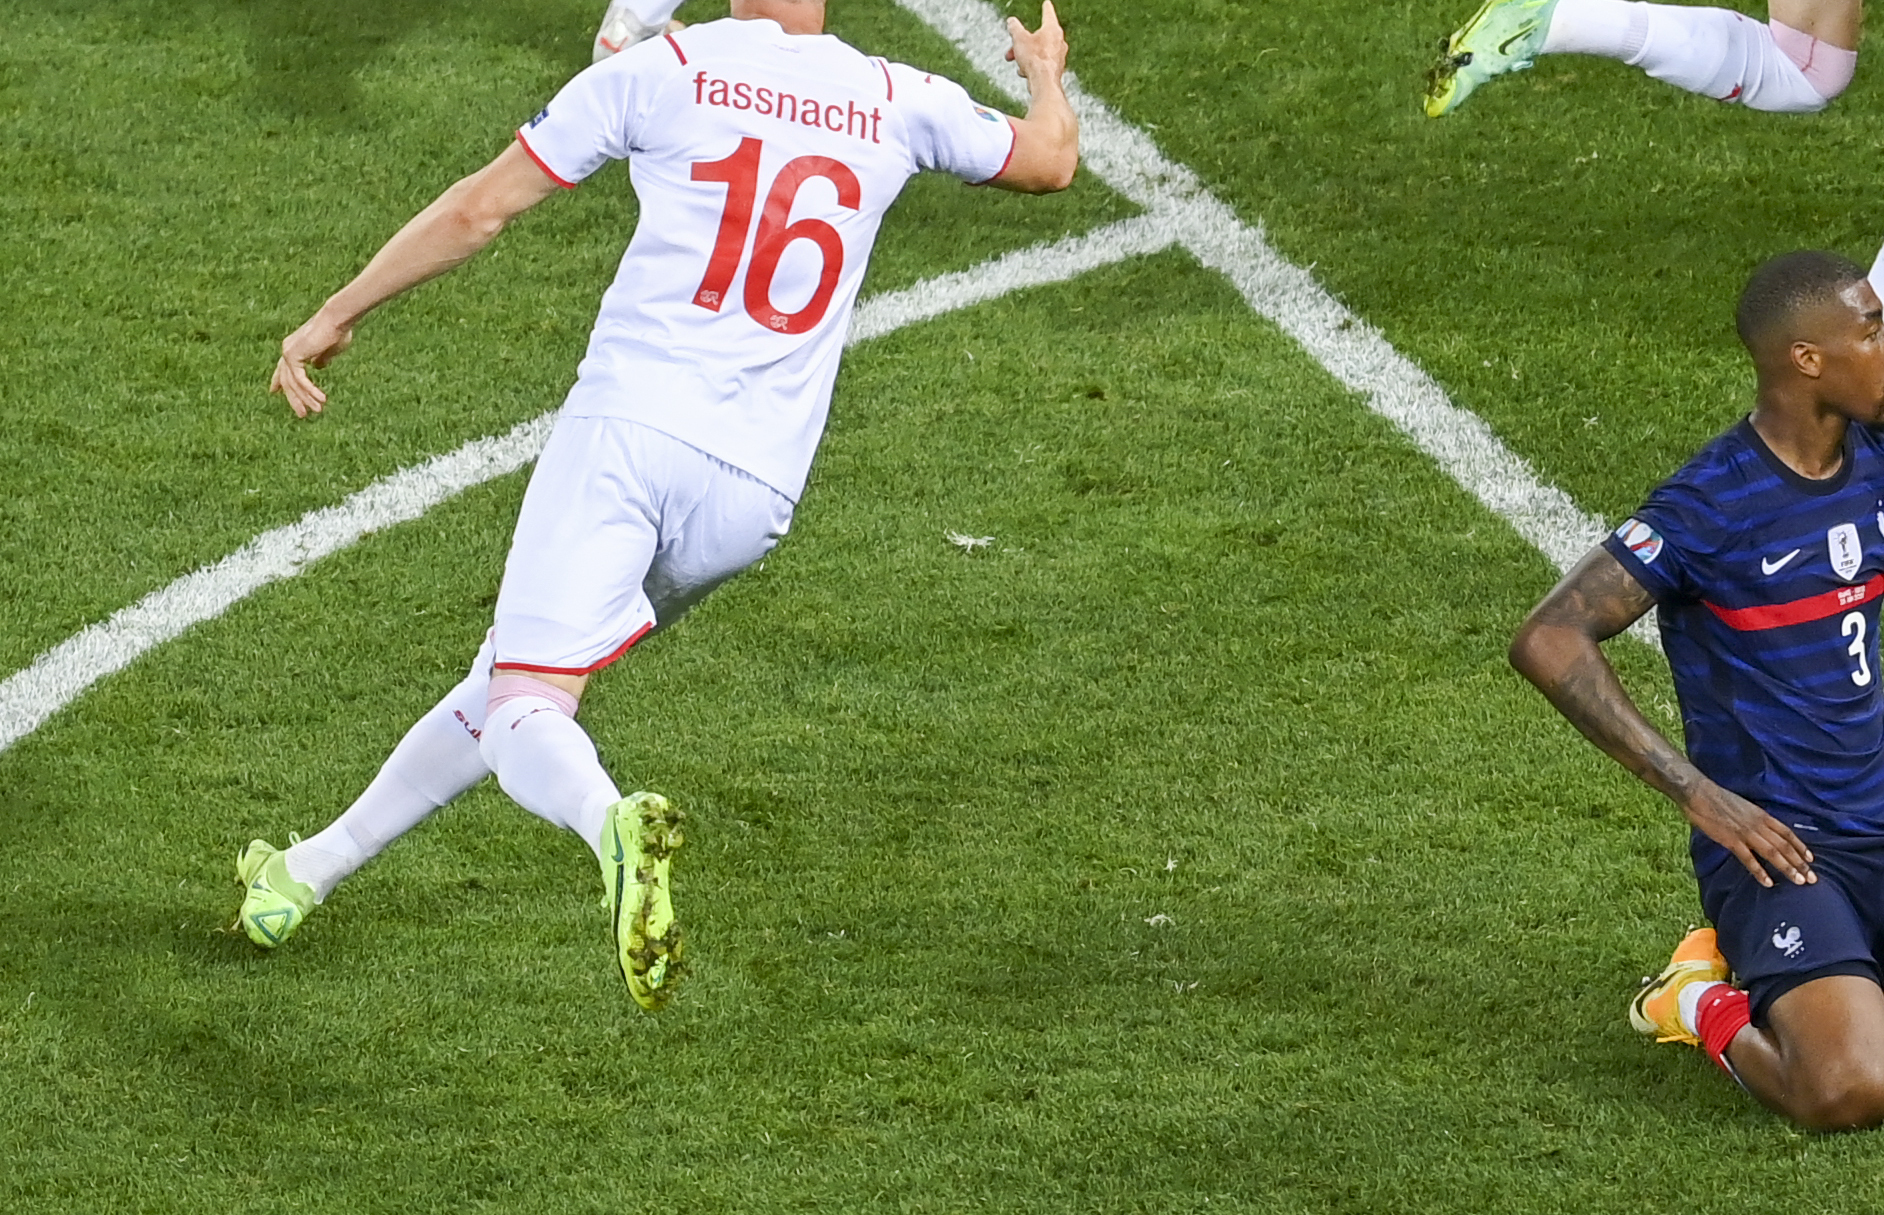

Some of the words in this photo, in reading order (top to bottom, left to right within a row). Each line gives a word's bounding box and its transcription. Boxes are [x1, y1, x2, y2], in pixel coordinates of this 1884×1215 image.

[693, 71, 882, 144] fassnacht
[690, 136, 862, 336] 16
[1842, 611, 1871, 686] 3
